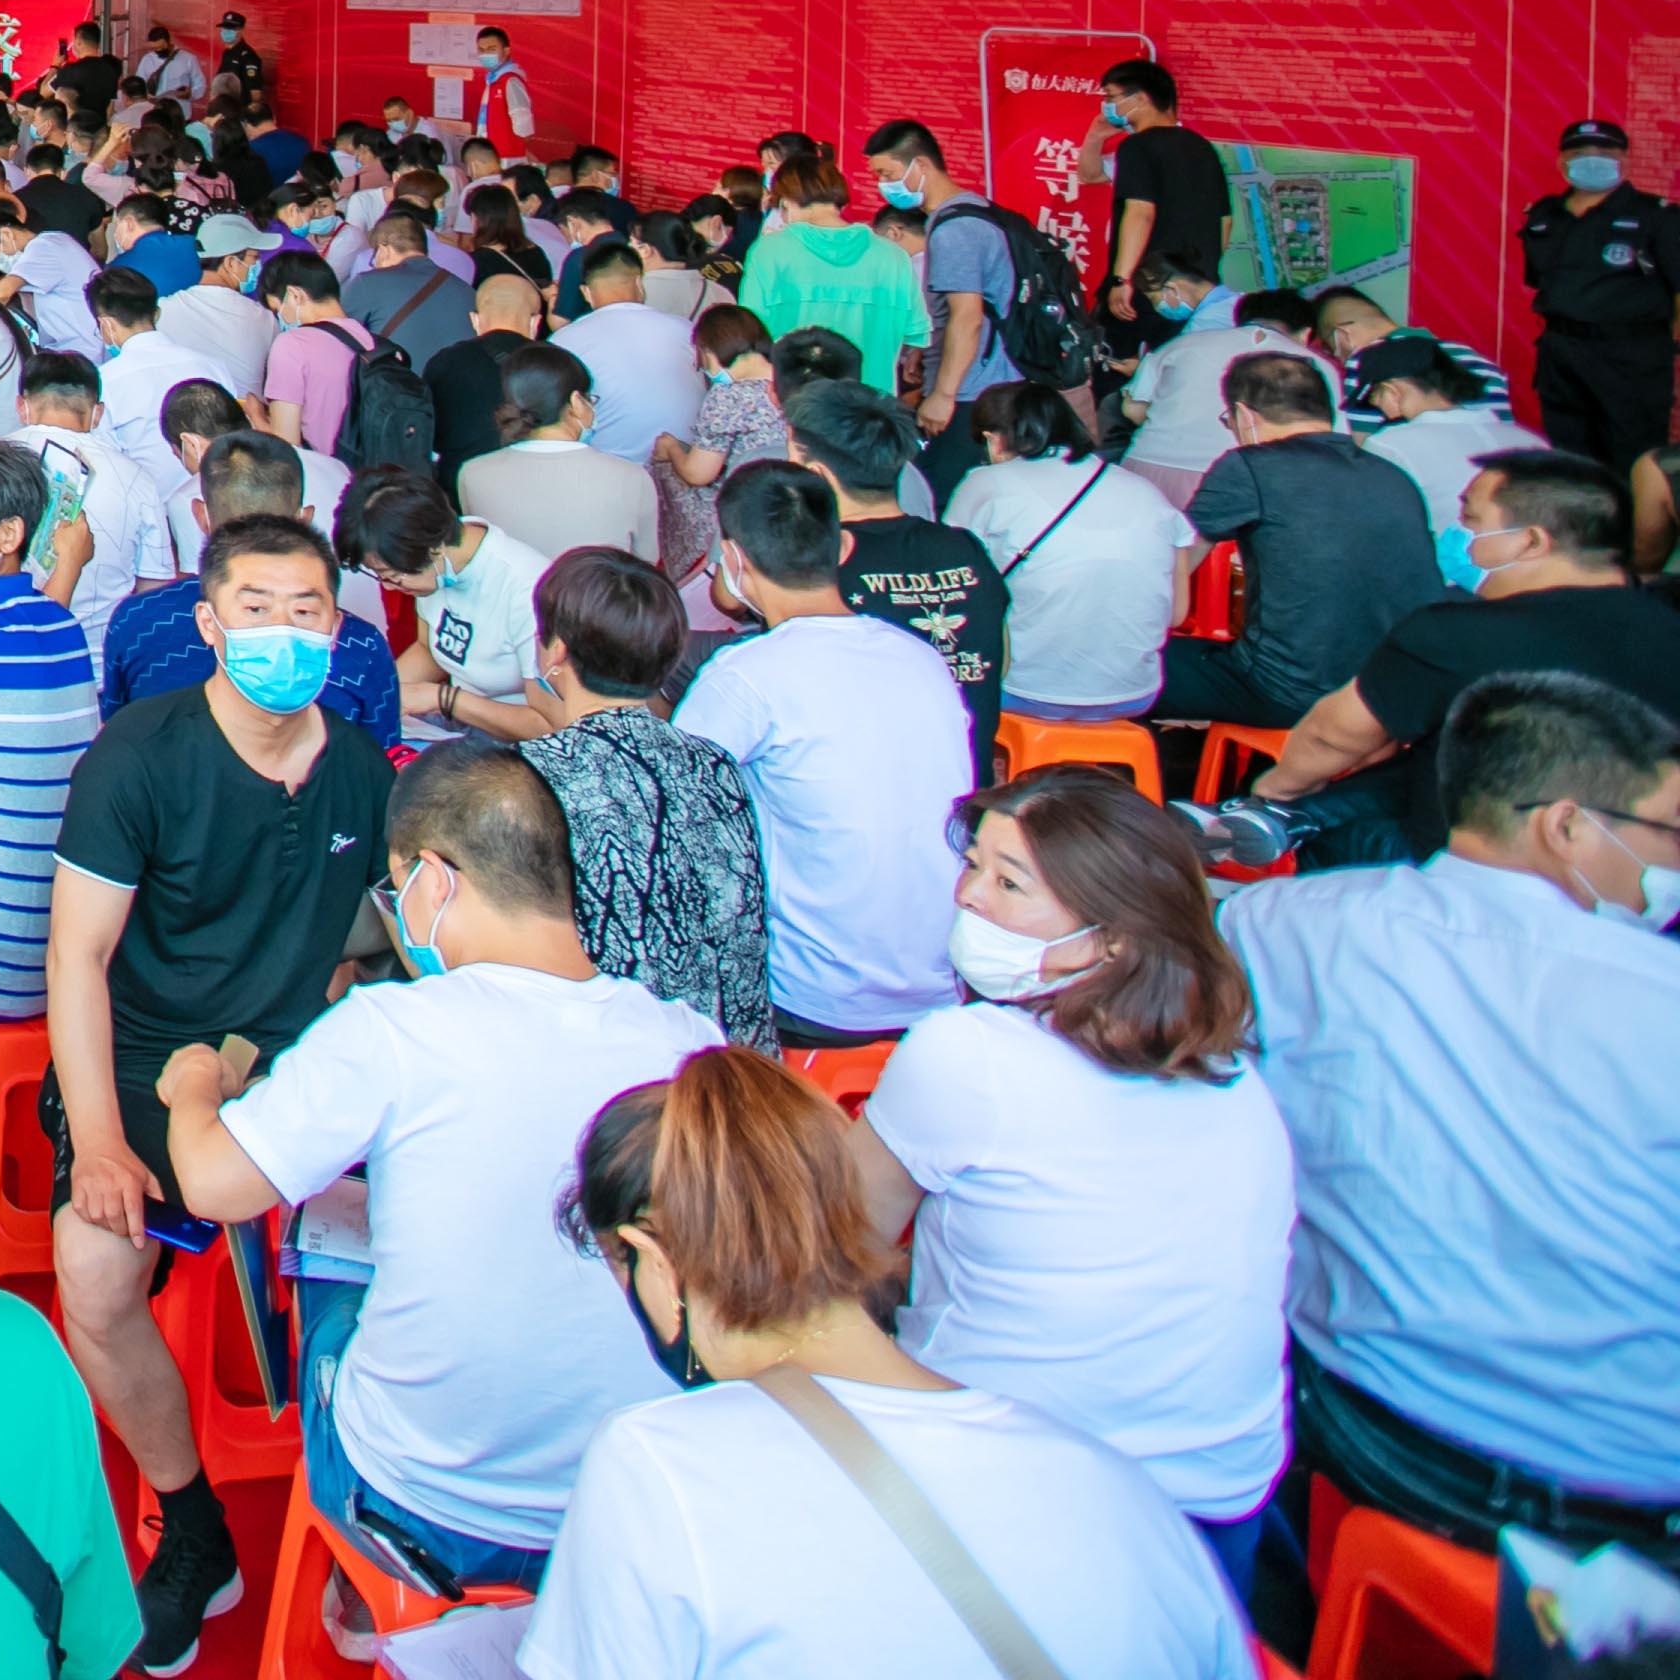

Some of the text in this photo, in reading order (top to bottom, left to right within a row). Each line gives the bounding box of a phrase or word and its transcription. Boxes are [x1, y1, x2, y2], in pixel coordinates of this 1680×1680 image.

[1031, 74, 1107, 95] 恒大滨河左
[860, 566, 978, 593] WILDLIFE
